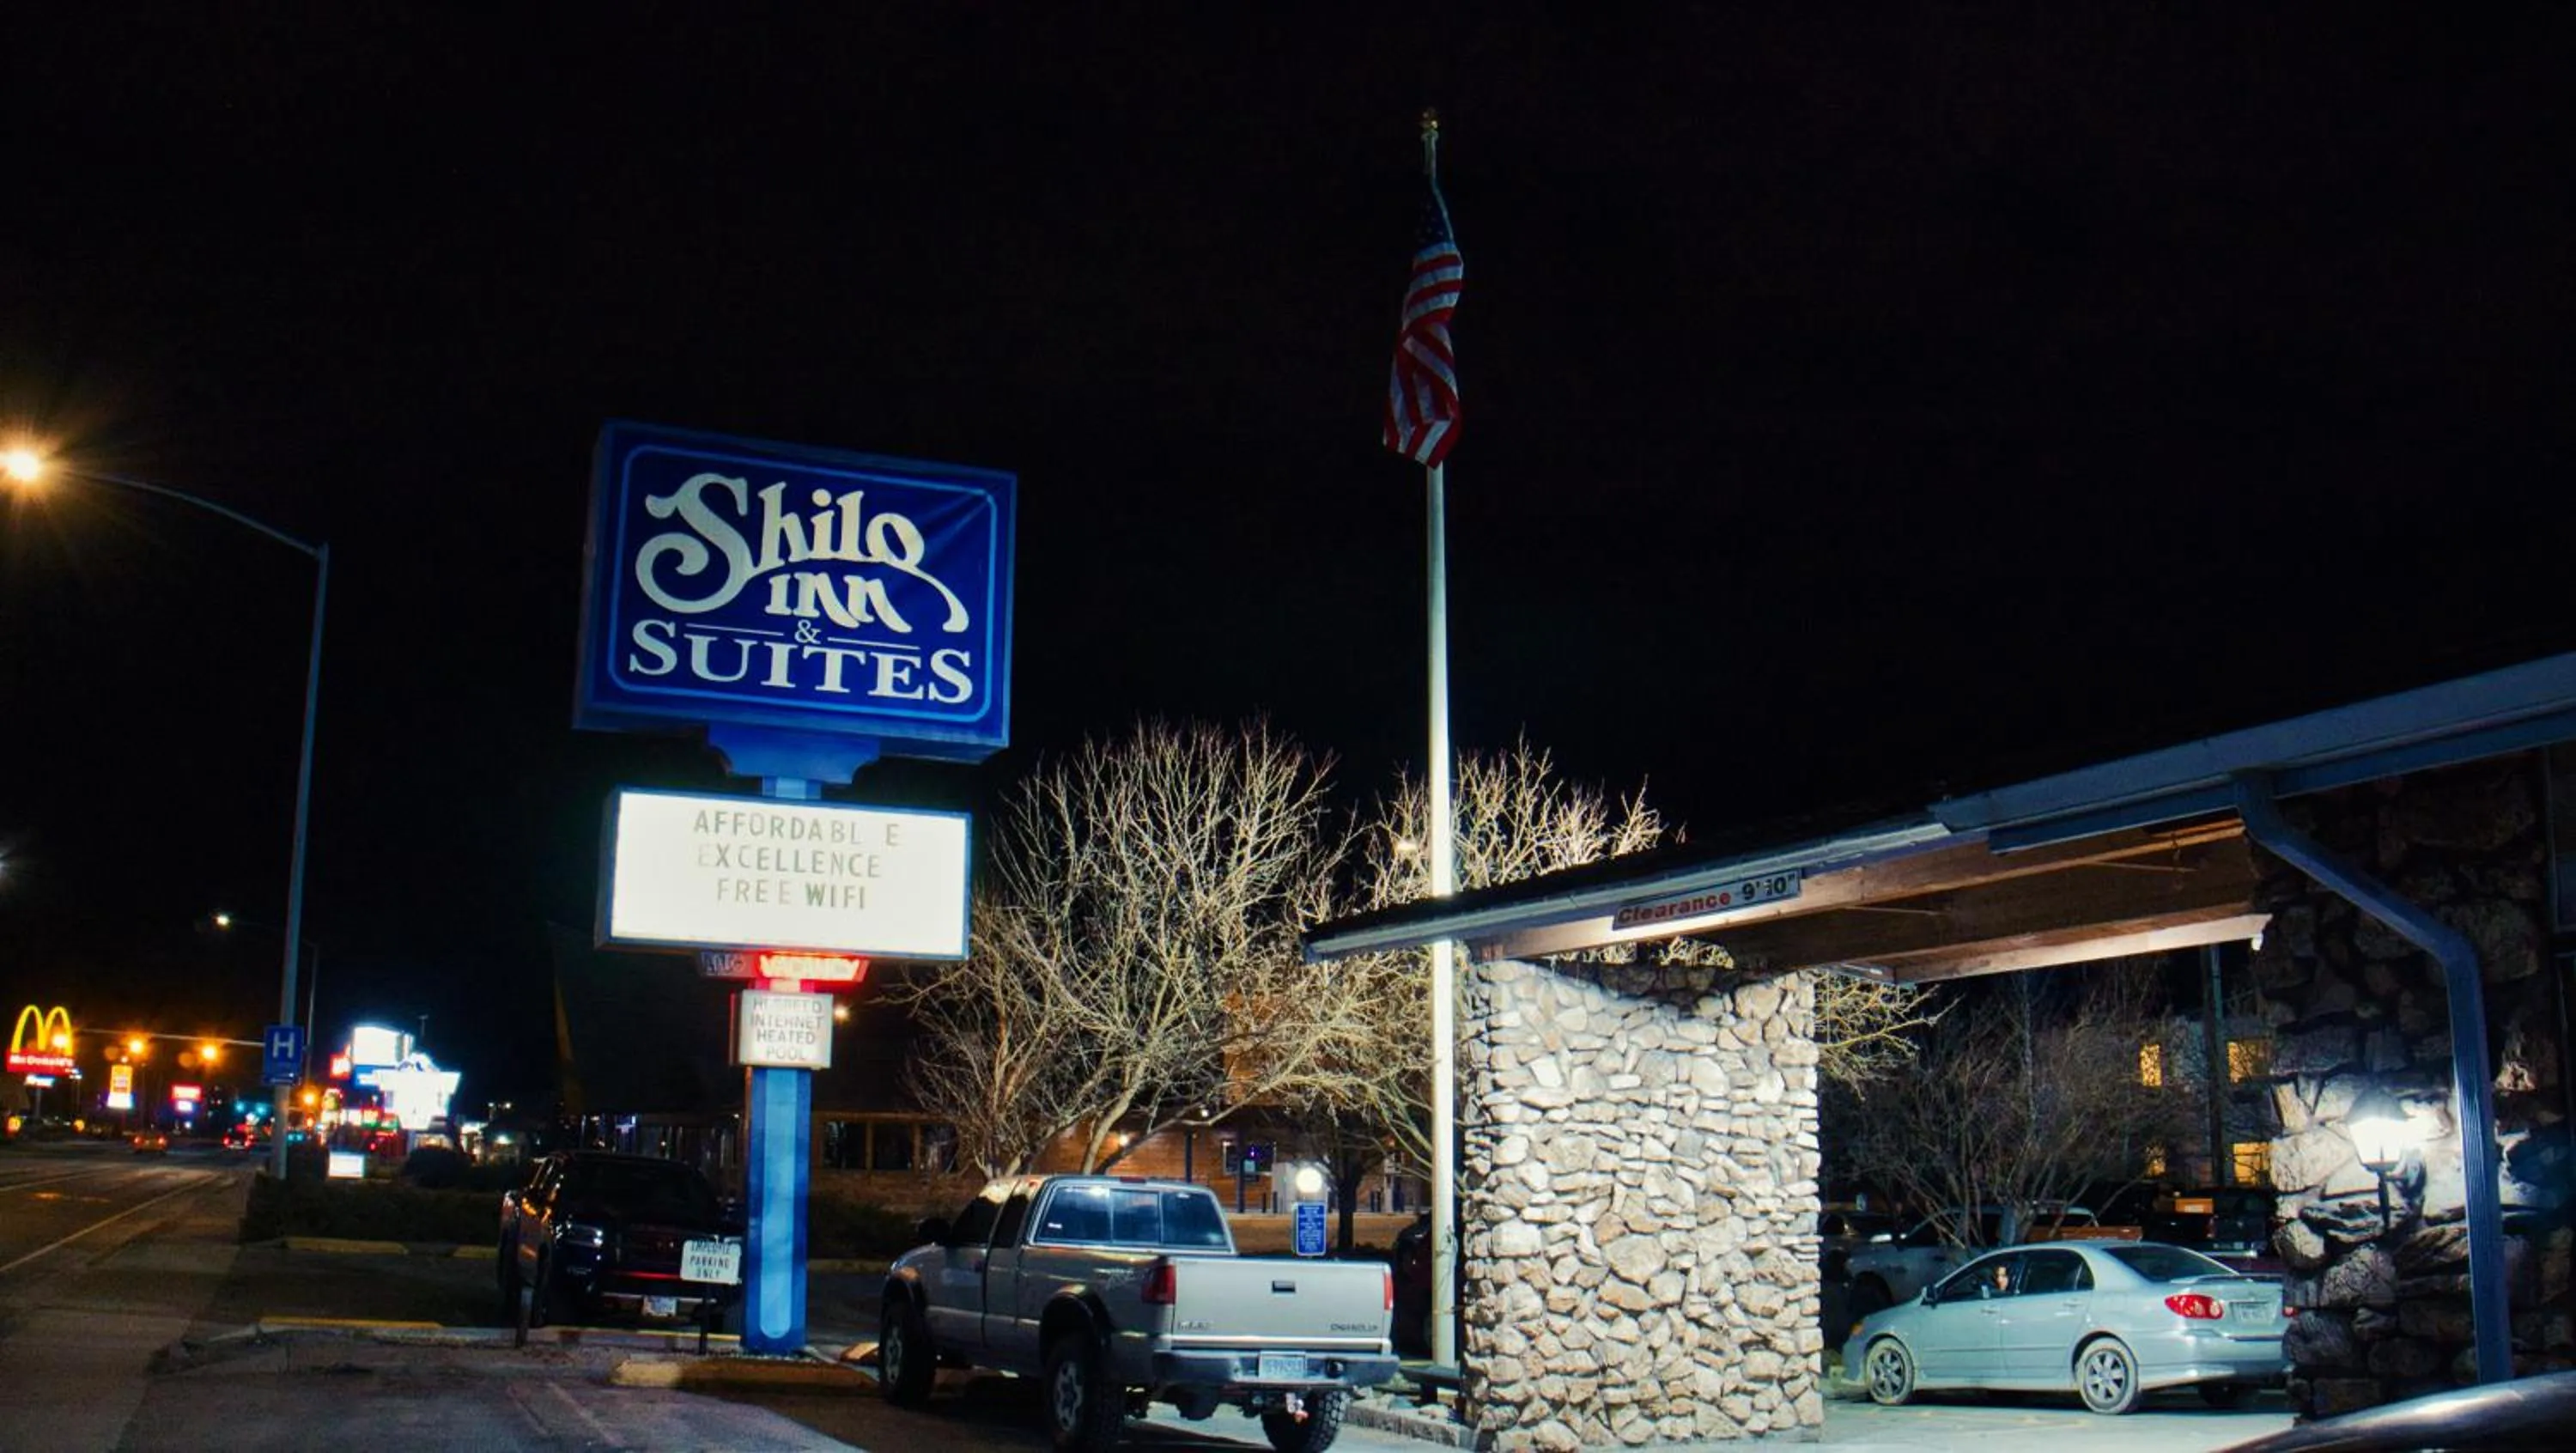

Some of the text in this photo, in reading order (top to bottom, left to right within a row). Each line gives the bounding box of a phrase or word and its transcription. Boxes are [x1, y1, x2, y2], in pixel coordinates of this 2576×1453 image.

[635, 473, 969, 632] Shilo
[793, 619, 822, 644] &
[629, 619, 973, 703] SUITES
[697, 843, 881, 878] EXCELLENCE
[717, 878, 866, 909] FREE WIFI
[1617, 892, 1732, 924] Clearance
[750, 1013, 824, 1030] INTERNET
[756, 1029, 815, 1045] HEATED
[272, 1032, 295, 1059] H
